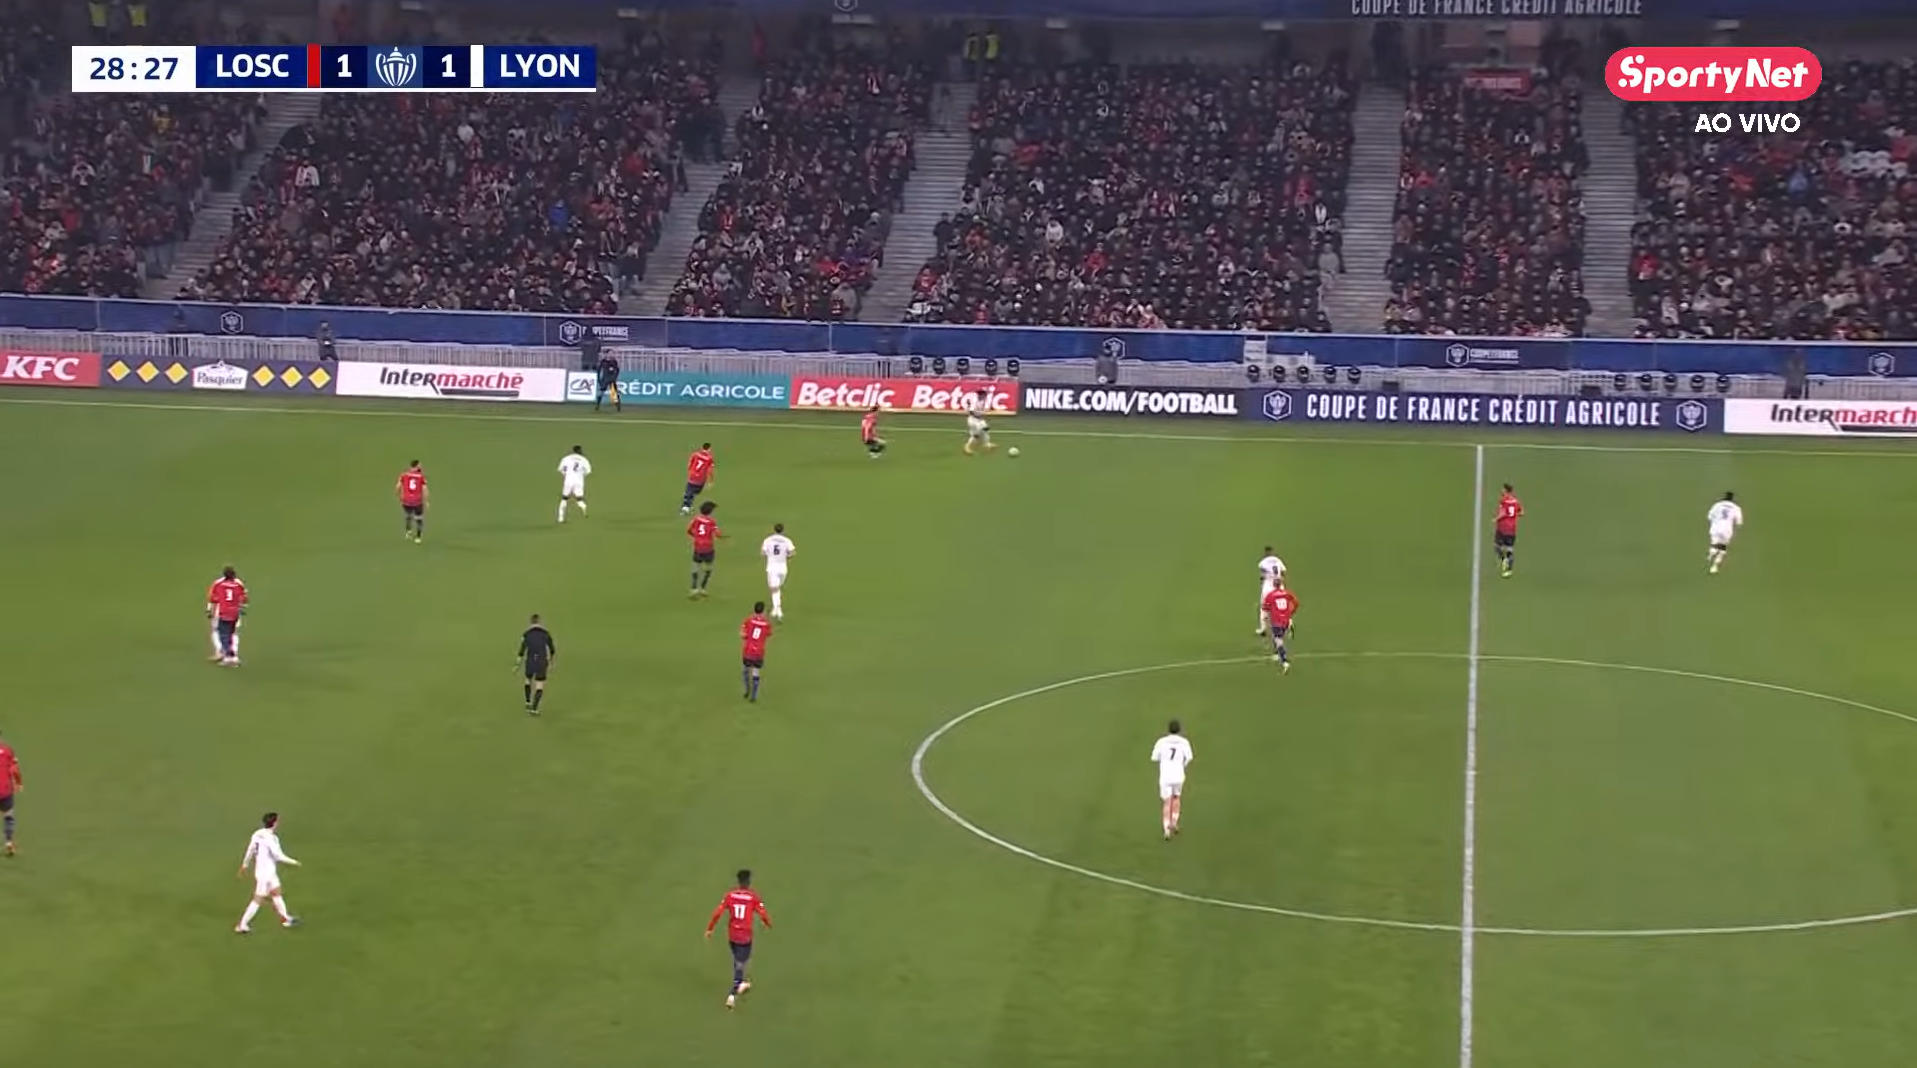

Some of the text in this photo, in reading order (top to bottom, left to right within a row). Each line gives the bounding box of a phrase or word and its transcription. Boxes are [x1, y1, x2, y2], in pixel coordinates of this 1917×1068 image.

[1408, 0, 1427, 15] DE
[1, 355, 80, 381] KFC
[196, 371, 244, 387] Pasquier
[606, 379, 785, 400] RÉDIT AGRICOLE
[797, 381, 896, 408] Betclic
[1025, 388, 1238, 414] NIKE.COM/FOOTBALL
[1307, 394, 1661, 426] COUPE DE FRANCE CRÉDIT AGRICOLE
[695, 459, 705, 470] 7
[408, 479, 417, 491] 6
[1508, 506, 1516, 517] 9
[698, 523, 706, 535] 5
[773, 544, 781, 556] 6
[1168, 747, 1177, 761] 7
[732, 903, 746, 920] 11
